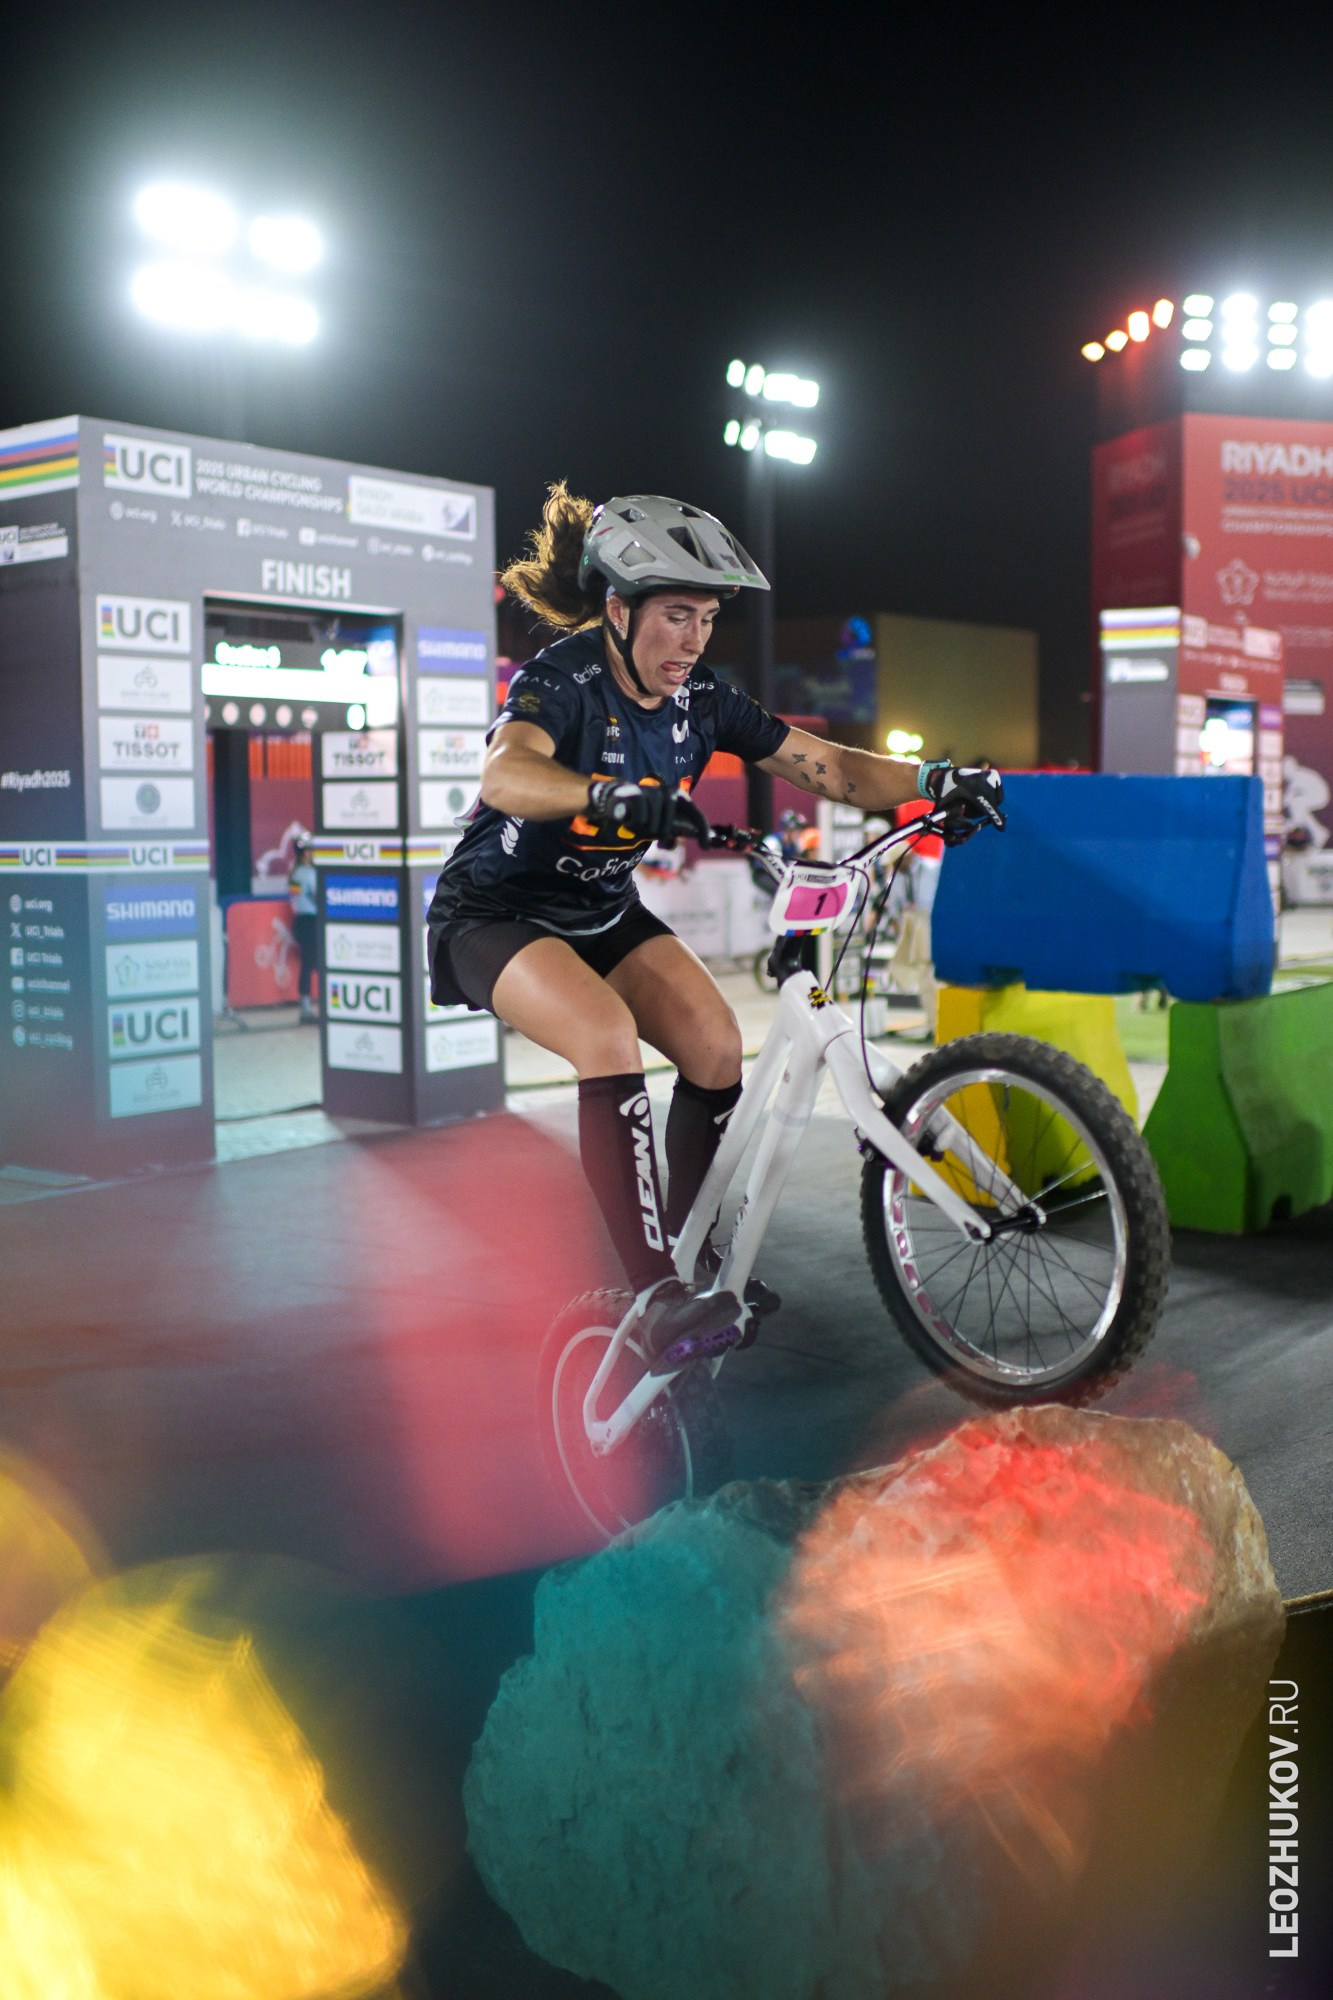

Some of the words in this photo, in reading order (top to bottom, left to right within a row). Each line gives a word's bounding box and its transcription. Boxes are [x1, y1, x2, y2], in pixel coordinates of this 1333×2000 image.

[120, 447, 183, 486] UCI
[1221, 440, 1333, 477] RIYADH
[225, 462, 270, 484] URBAN
[270, 470, 323, 494] CYCLING
[196, 476, 243, 499] WORLD
[244, 482, 344, 515] CHAMPIONSHIPS
[262, 558, 351, 598] FINISH
[117, 606, 181, 643] UCI
[113, 742, 180, 758] TISSOT
[333, 751, 386, 766] TISSOT
[430, 751, 478, 764] TISSOT
[1, 769, 71, 793] #Riyadh2025
[21, 847, 52, 867] UCI
[131, 845, 169, 866] UCI
[344, 843, 375, 860] UCI
[106, 898, 195, 921] SHIMANO
[326, 887, 398, 908] SHIMANO
[814, 893, 828, 916] 1
[342, 983, 392, 1013] UCI
[127, 1006, 190, 1046] UCI
[631, 1126, 665, 1252] CLEAN
